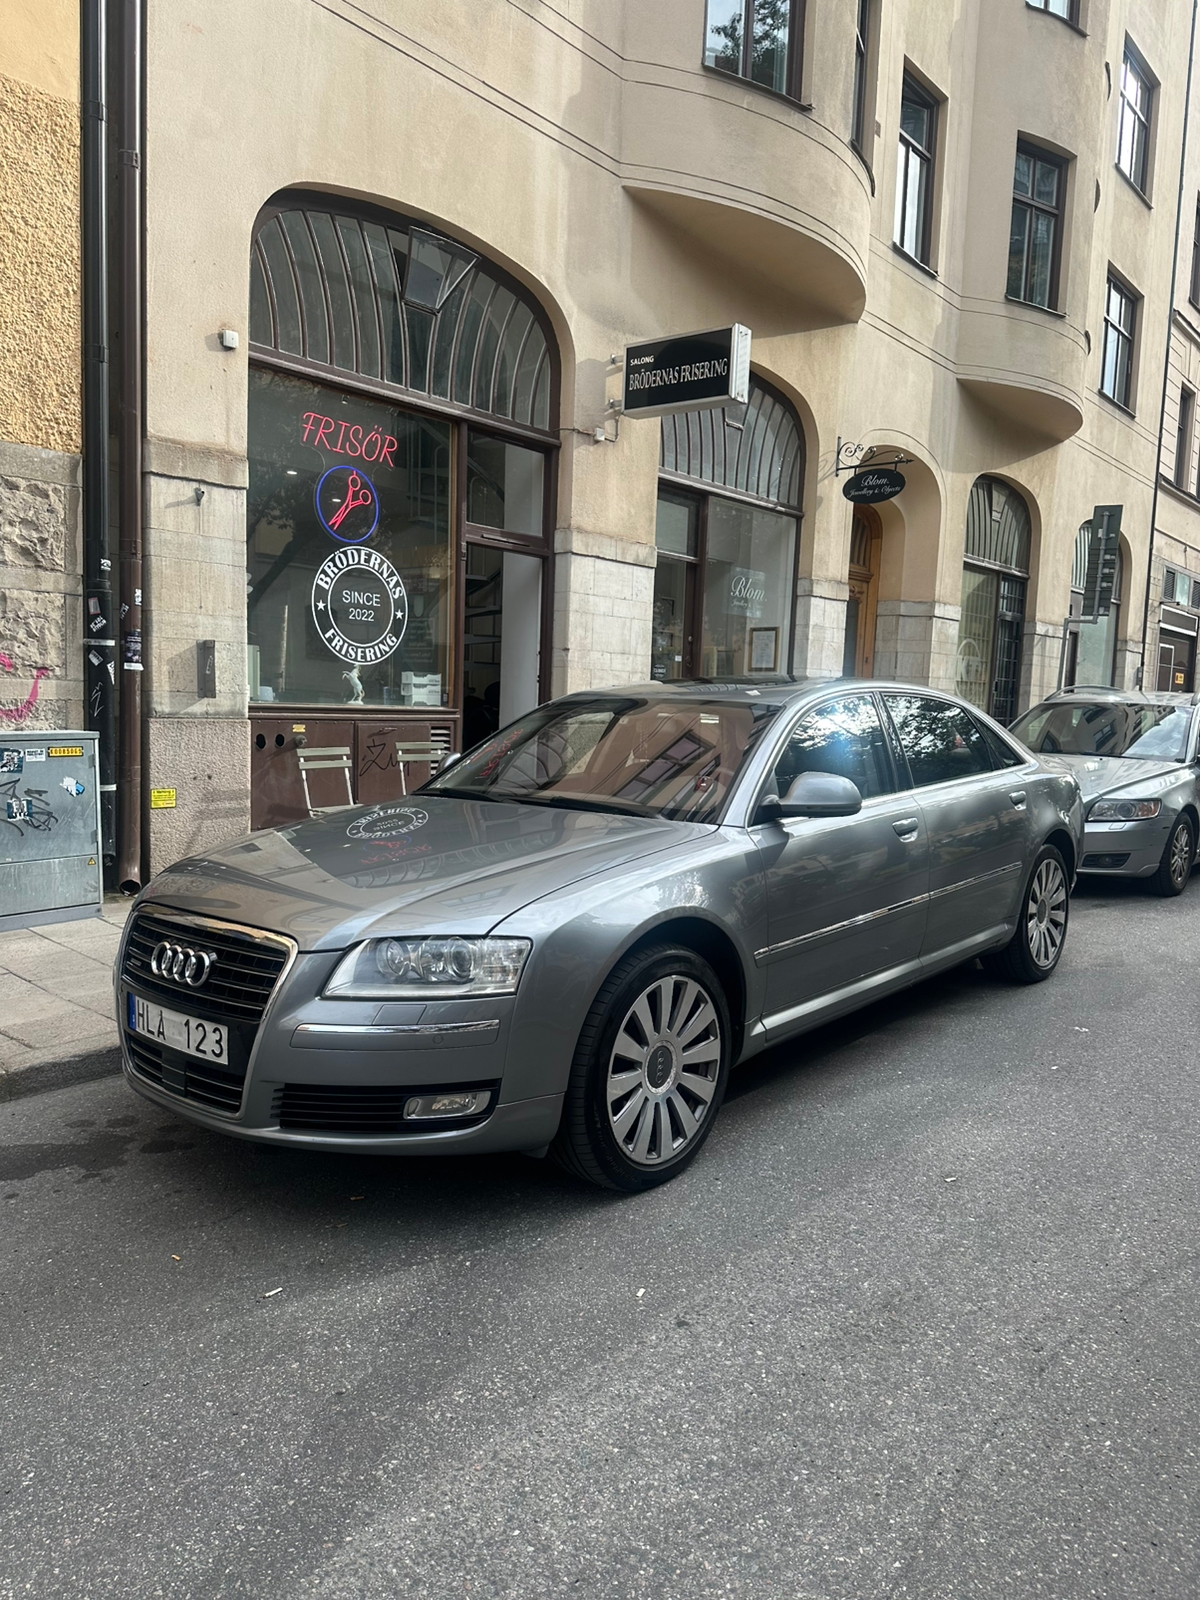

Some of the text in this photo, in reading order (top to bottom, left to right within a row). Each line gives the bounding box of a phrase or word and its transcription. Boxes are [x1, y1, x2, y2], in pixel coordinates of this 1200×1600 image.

[629, 358, 728, 391] BRÖDERNAS FRISERING
[630, 355, 655, 366] SALONG
[302, 411, 398, 468] FRISÖR
[316, 548, 405, 600] BRÖDERNAS
[342, 589, 381, 607] SINCE
[348, 607, 375, 622] 2022
[324, 627, 398, 663] FRISERING
[137, 999, 223, 1058] HLA 123
